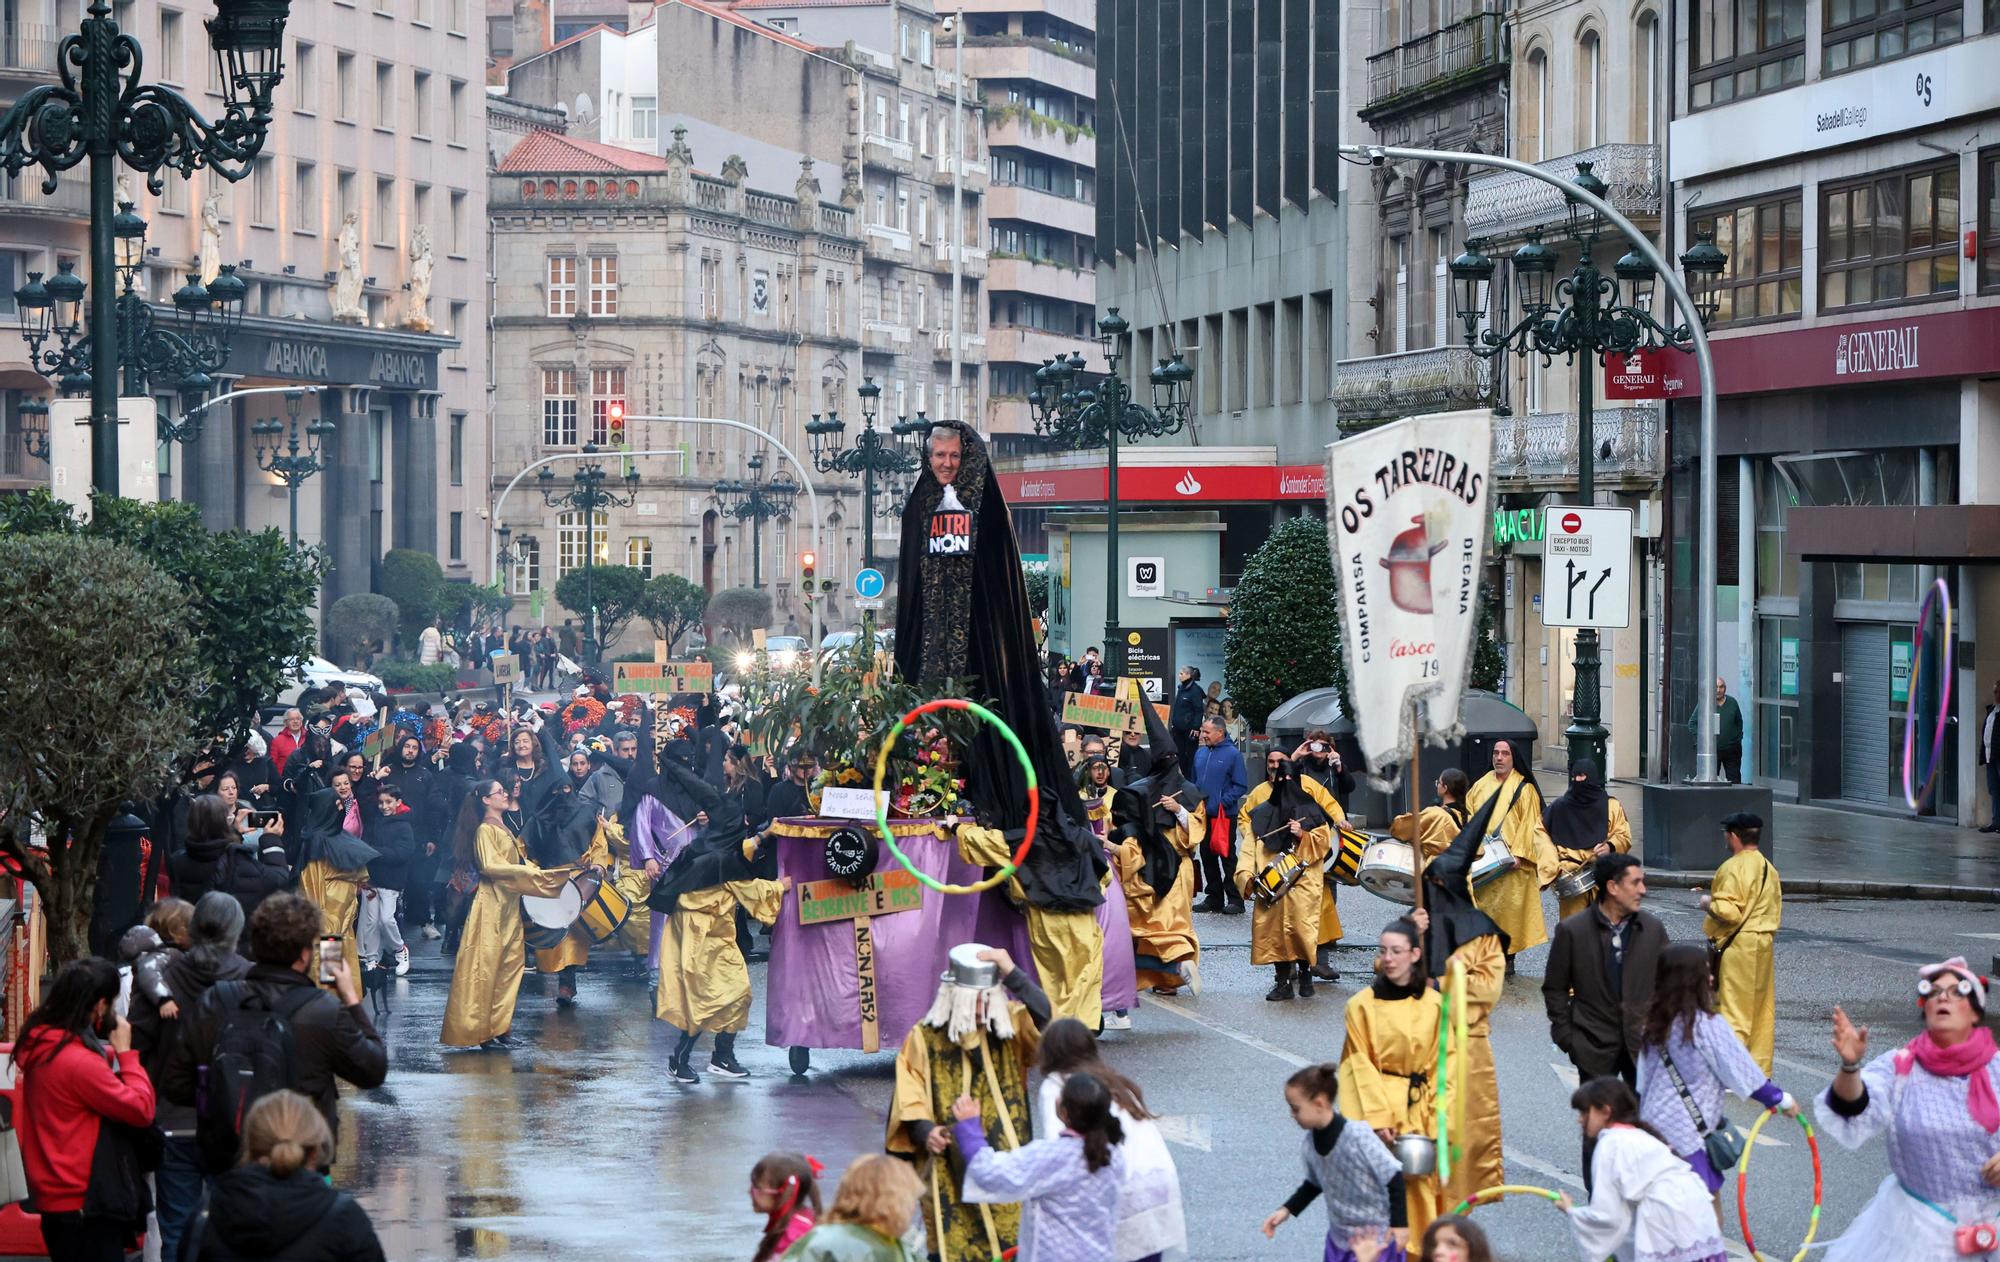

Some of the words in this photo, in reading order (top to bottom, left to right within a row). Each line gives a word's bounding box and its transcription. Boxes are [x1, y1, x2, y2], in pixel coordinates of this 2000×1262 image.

[274, 343, 328, 377] ABANCA
[1848, 326, 1919, 373] GENERALI
[377, 352, 427, 384] ABANCA
[1613, 375, 1655, 384] GENERALI
[1286, 475, 1308, 493] Santander
[1342, 487, 1373, 533] OS
[1375, 447, 1482, 504] TAREIRAS
[930, 513, 970, 537] ALTRI
[929, 535, 970, 553] NON
[1460, 538, 1473, 614] DECANA
[1352, 552, 1371, 663] COMPARSA
[618, 666, 625, 679] A
[662, 665, 677, 677] FAI
[677, 678, 684, 691] E
[1146, 680, 1154, 692] 2
[1068, 693, 1076, 706] A
[1115, 701, 1132, 714] FAI
[1129, 716, 1137, 730] E
[802, 885, 811, 902] A
[857, 875, 875, 893] AI
[875, 891, 884, 909] E
